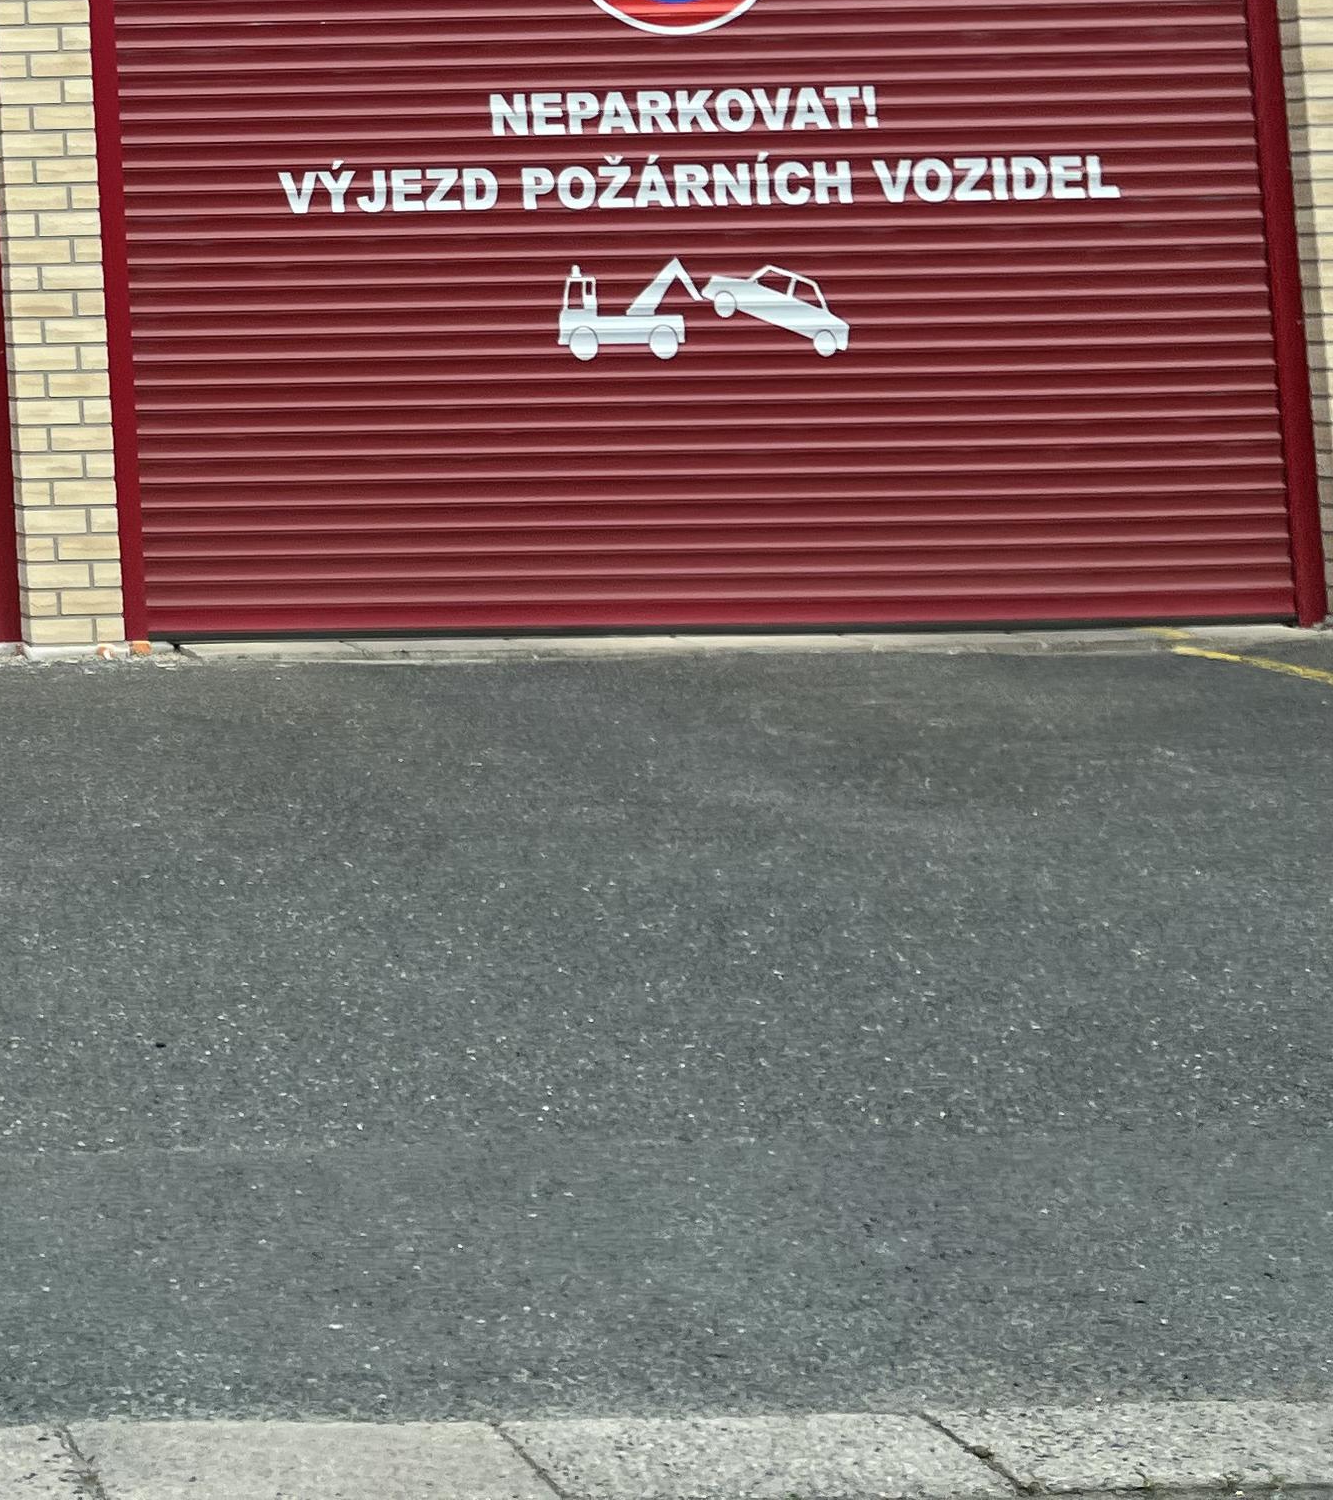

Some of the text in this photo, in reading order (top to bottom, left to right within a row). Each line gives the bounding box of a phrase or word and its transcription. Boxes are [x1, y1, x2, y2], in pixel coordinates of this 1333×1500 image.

[489, 85, 879, 137] NEPARKOVAT!
[278, 151, 1121, 215] VÝJEZD POŽÁRNÍCH VOZIDEL
